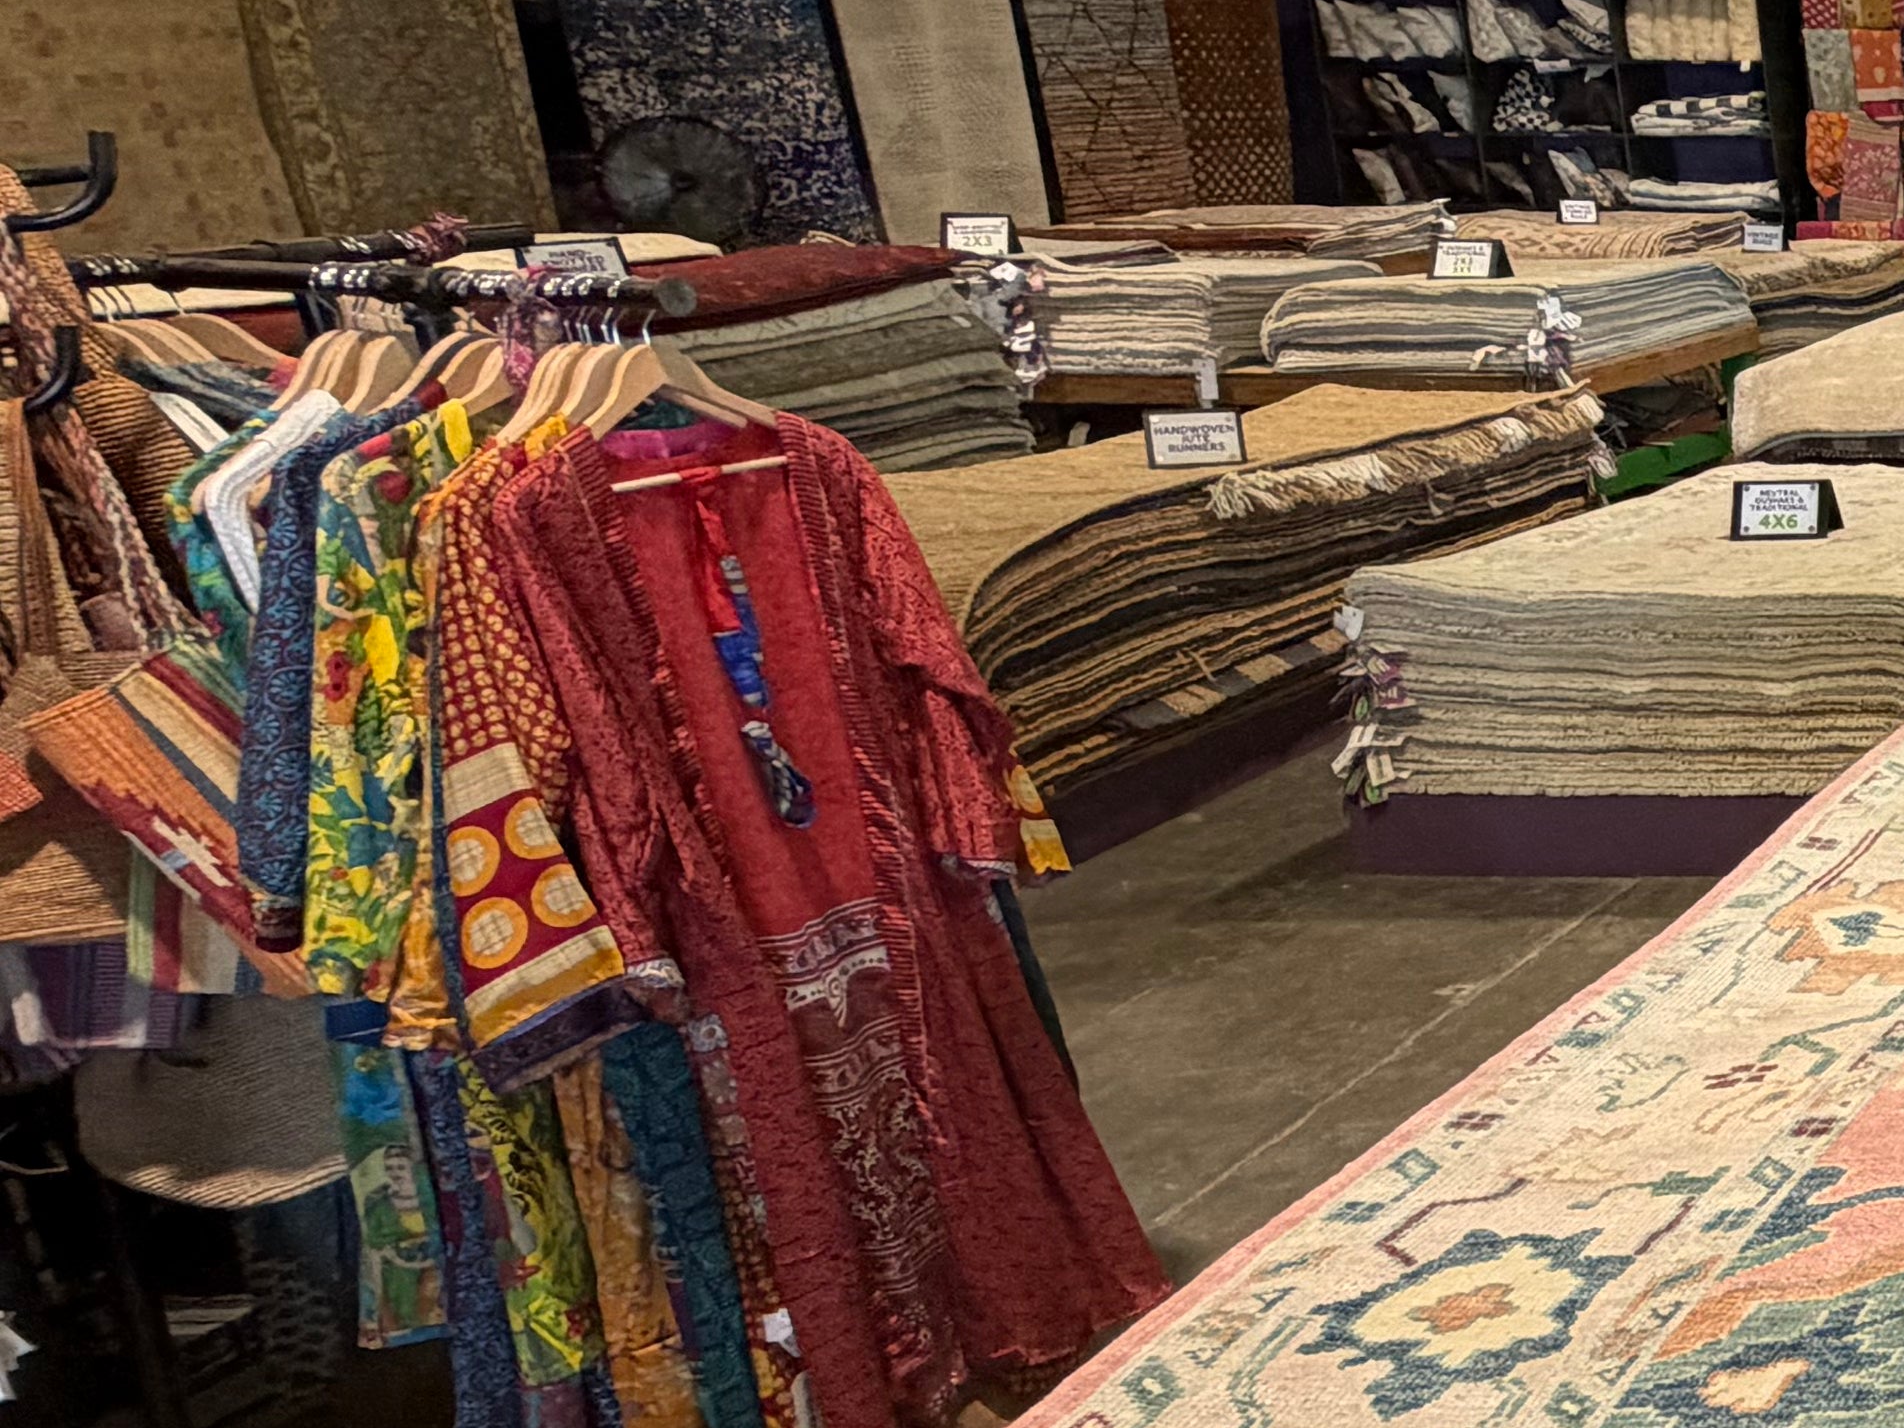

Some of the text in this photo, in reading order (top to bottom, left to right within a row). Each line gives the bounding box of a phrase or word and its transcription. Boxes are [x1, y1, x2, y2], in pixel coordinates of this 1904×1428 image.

[962, 235, 993, 247] 2X3
[1154, 424, 1235, 435] HANDWOVEN
[1168, 442, 1226, 452] RUNNERS
[1759, 514, 1798, 529] 4X6
